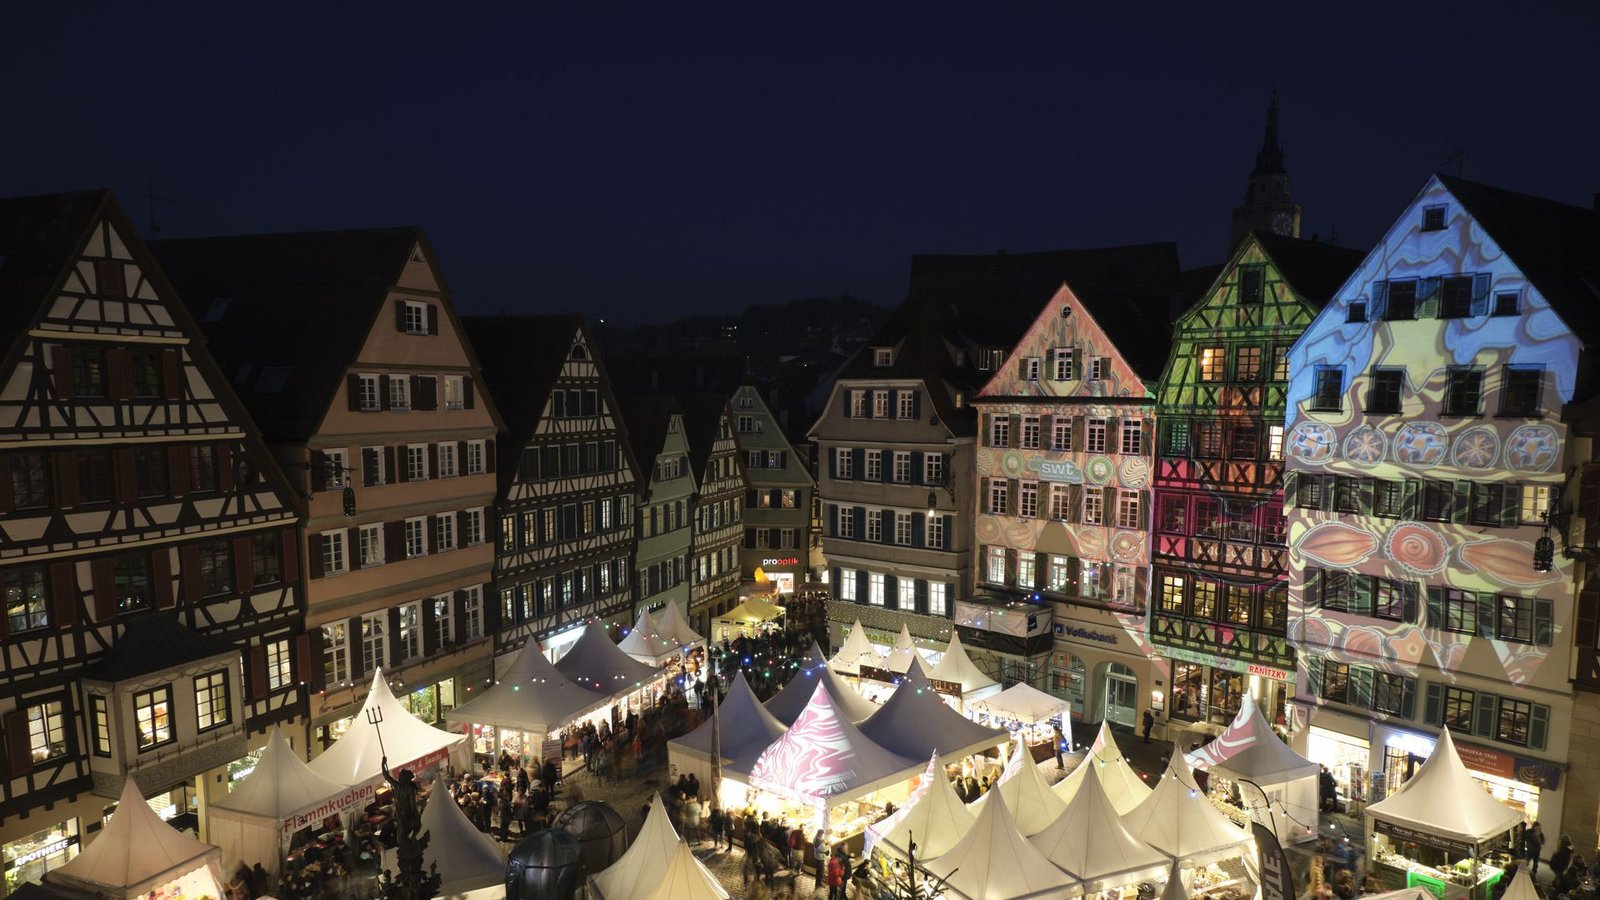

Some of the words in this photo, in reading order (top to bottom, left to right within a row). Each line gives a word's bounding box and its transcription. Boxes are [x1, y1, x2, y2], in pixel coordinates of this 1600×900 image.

[1042, 463, 1073, 476] swt
[763, 558, 799, 566] prooptik
[1065, 625, 1118, 645] Volksbank
[1249, 664, 1287, 680] RANITZKY
[284, 783, 373, 833] Flammkuchen
[14, 839, 69, 867] APOTHEKE
